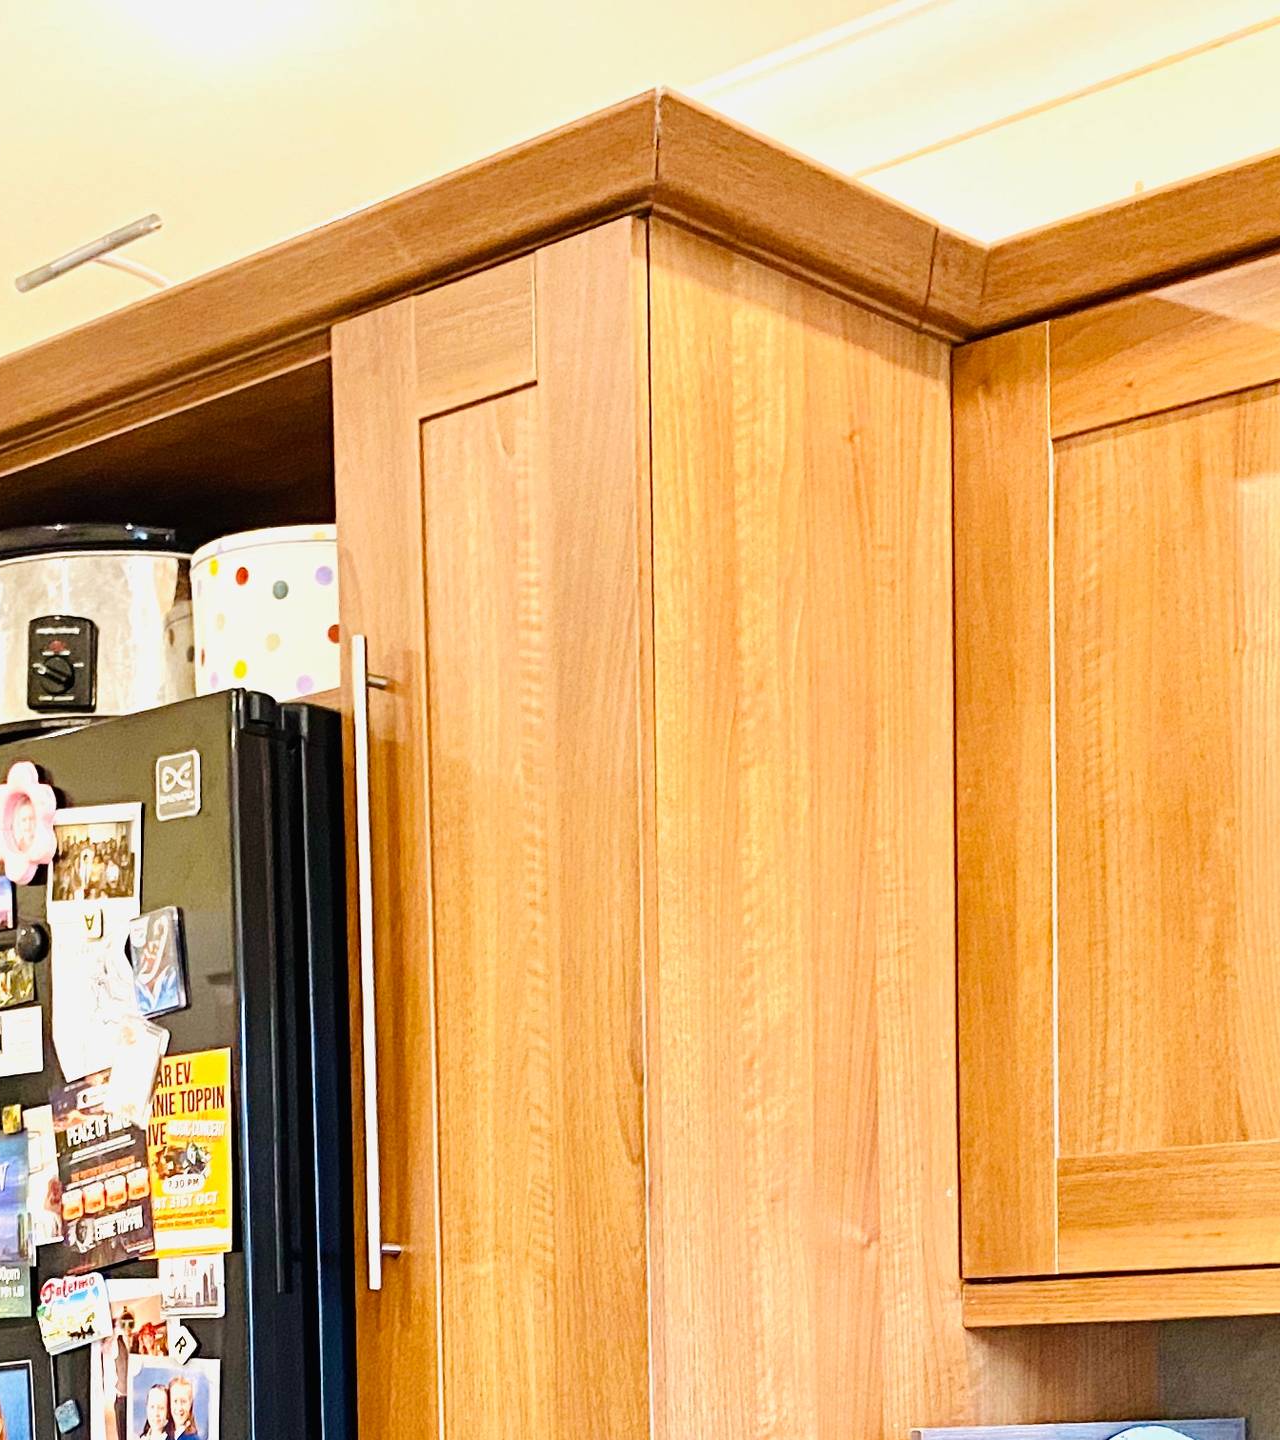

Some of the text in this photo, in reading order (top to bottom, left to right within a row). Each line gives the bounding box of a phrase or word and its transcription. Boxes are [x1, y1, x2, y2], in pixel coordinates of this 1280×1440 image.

[179, 1086, 225, 1113] TOPPIN
[67, 1120, 96, 1147] PEACE
[175, 1336, 187, 1354] R
